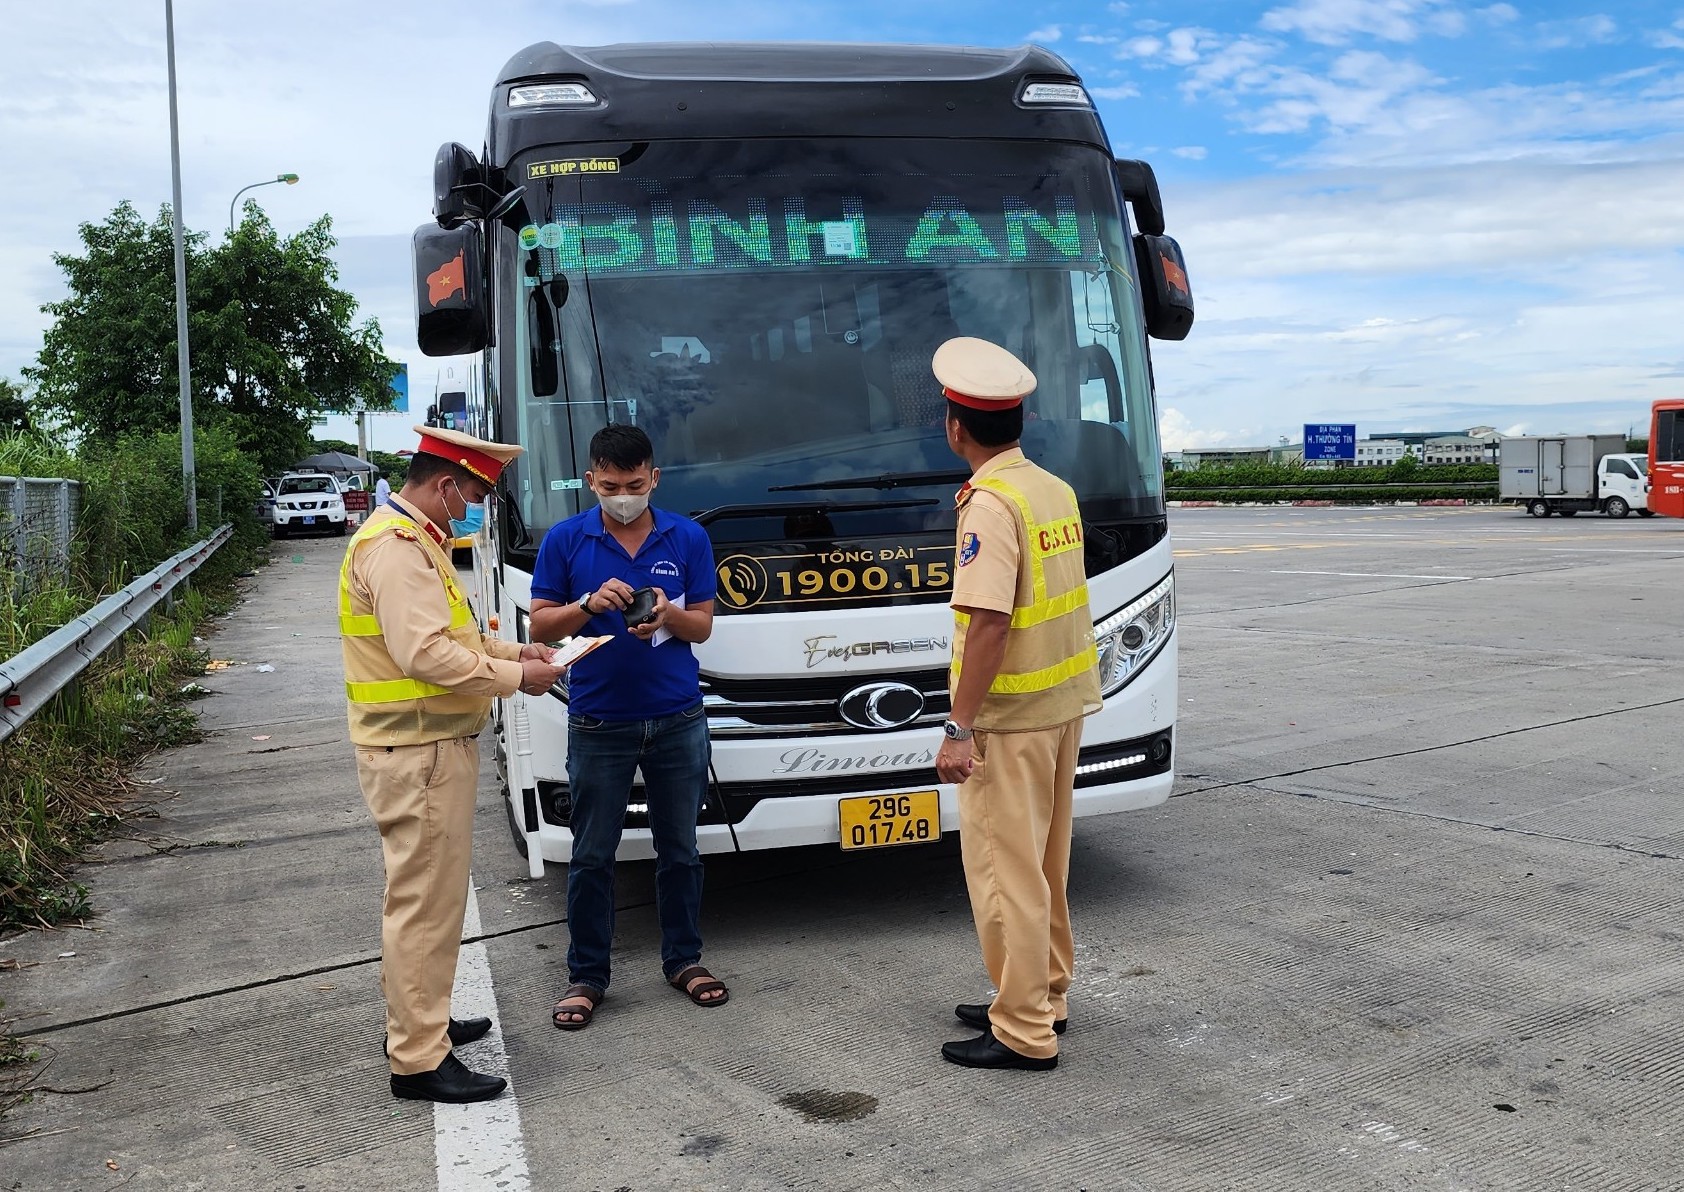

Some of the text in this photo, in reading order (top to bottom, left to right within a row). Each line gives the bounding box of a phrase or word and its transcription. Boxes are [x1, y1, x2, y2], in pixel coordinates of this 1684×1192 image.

[531, 166, 547, 176] XE
[550, 162, 577, 175] HỢP
[906, 195, 1083, 259] AN
[1664, 485, 1684, 494] 18B-
[817, 545, 914, 564] TỔNG ĐÀI
[772, 747, 936, 774] Limous
[868, 796, 911, 820] 29G
[851, 818, 929, 846] 017.48
